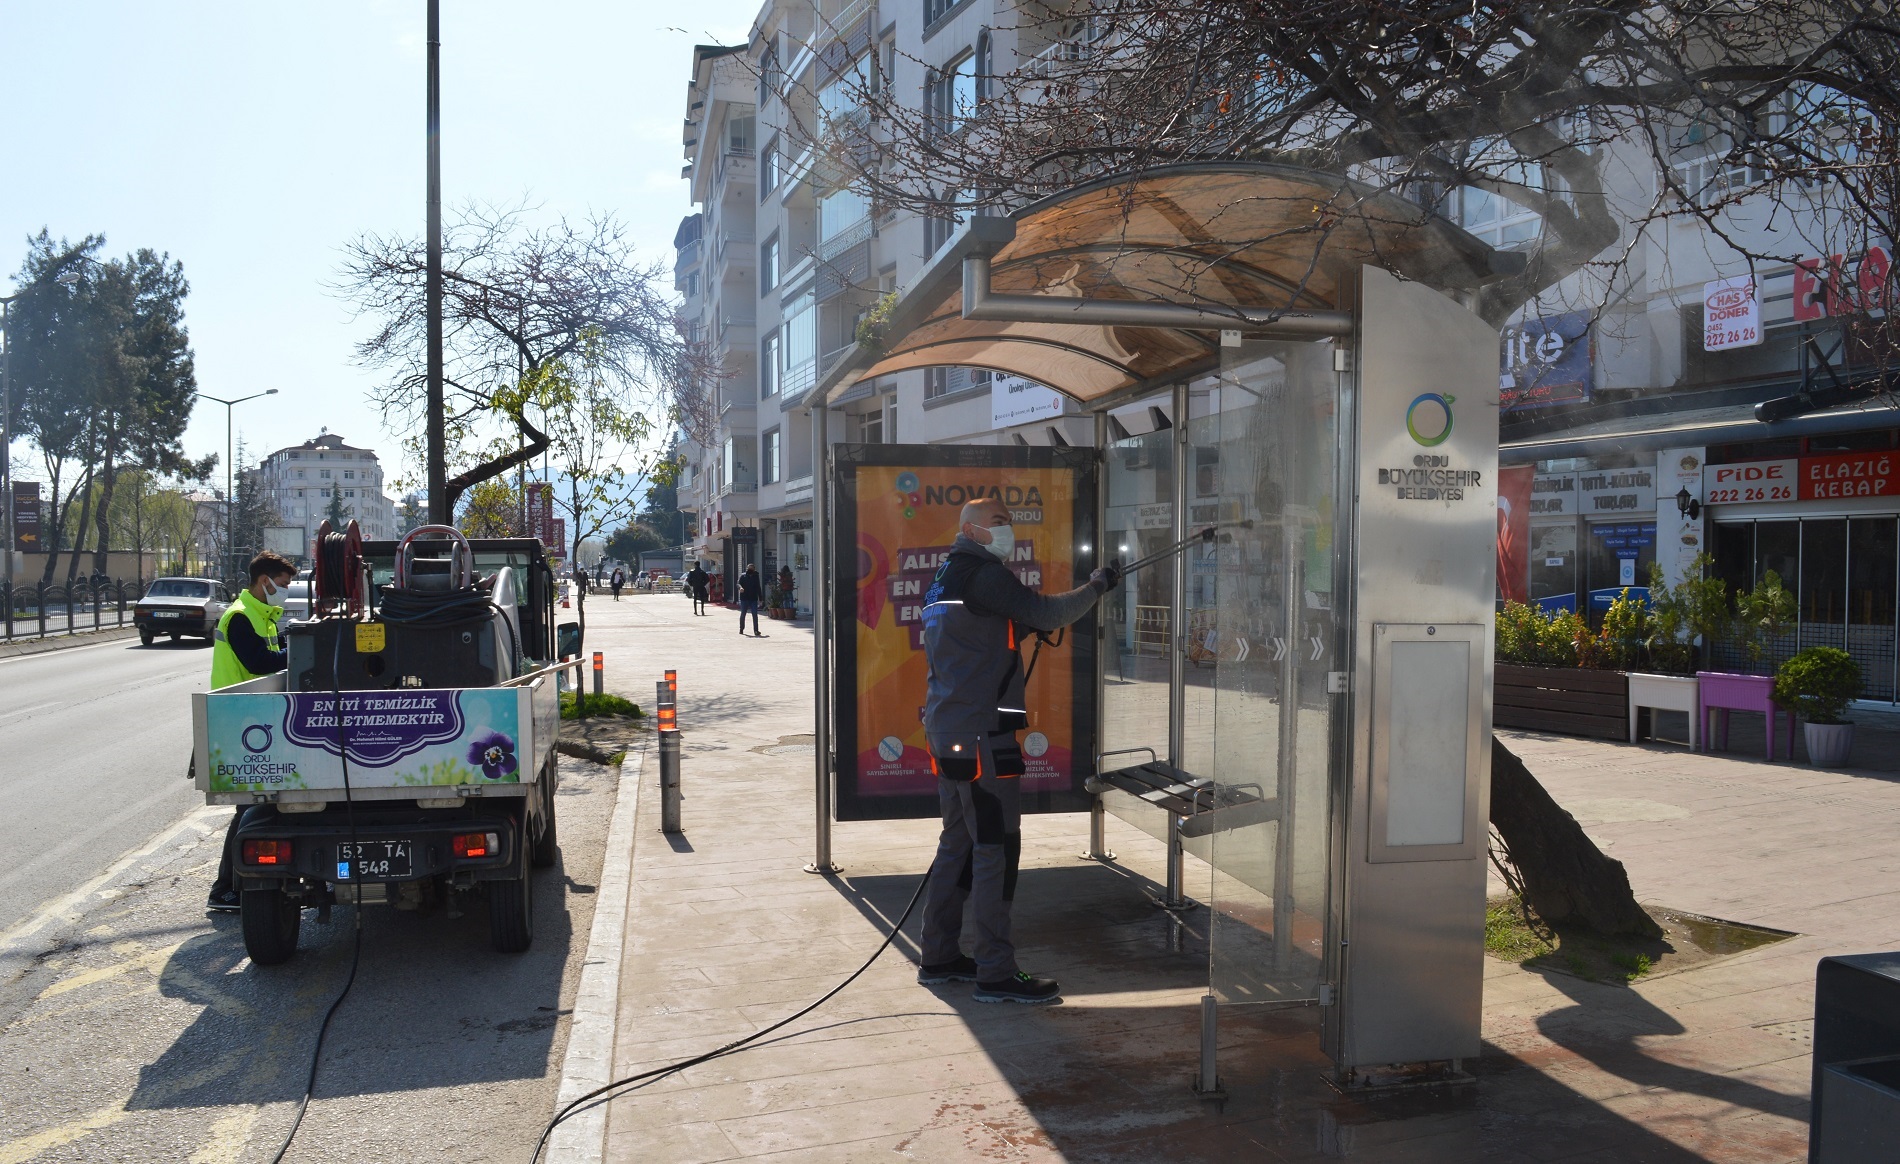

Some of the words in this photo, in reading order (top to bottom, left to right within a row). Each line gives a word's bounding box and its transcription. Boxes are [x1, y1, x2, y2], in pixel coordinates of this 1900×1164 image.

[1717, 293, 1740, 306] HAS
[1709, 307, 1749, 322] DÖNER
[1707, 323, 1723, 331] 0452
[1706, 333, 1724, 347] 222
[1727, 330, 1740, 343] 26
[1743, 327, 1755, 340] 26
[1412, 455, 1449, 467] ORDU
[1810, 456, 1890, 480] ELAZIĞ
[925, 485, 1043, 506] NOVADA
[1709, 489, 1739, 502] 222
[1745, 488, 1765, 501] 26
[1771, 486, 1791, 499] 26
[1814, 479, 1887, 498] KEBAP
[893, 580, 920, 596] EN
[312, 700, 336, 712] EN
[339, 697, 360, 711] İYİ
[364, 695, 437, 711] TEMİZLİK
[305, 711, 445, 728] KİRLETMEMEKTİR
[243, 755, 271, 763] ORDU
[384, 844, 405, 858] TA
[359, 860, 389, 874] 548
